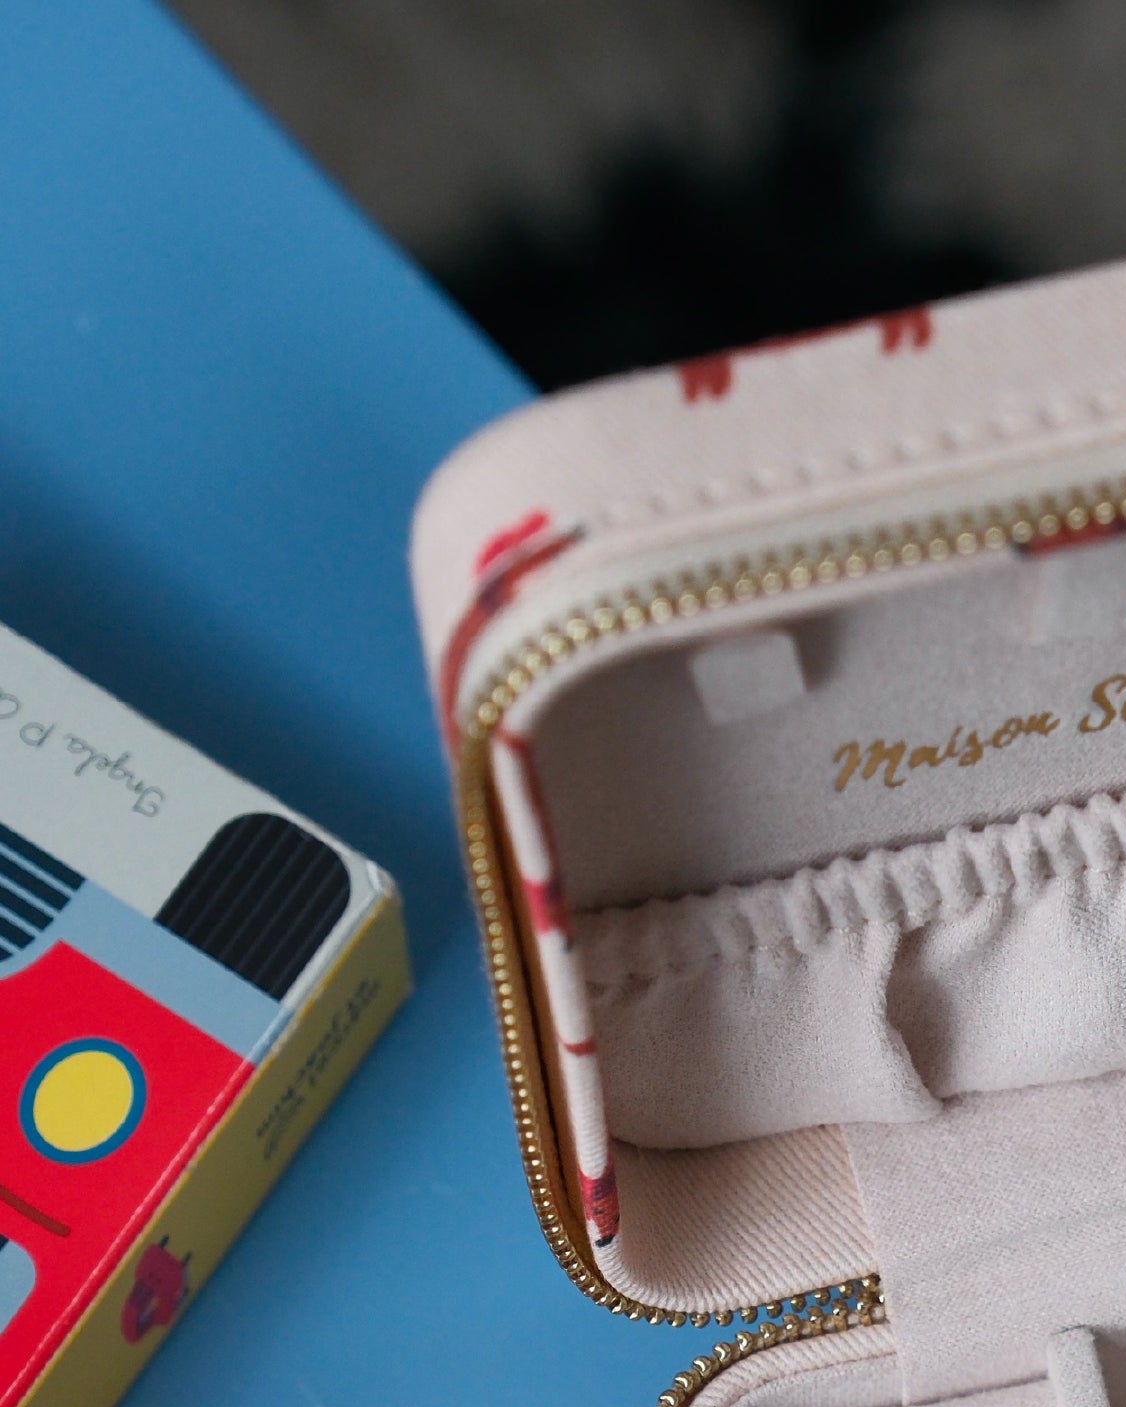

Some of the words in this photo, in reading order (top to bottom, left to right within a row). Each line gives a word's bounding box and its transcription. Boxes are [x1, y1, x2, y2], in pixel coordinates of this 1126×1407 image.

[19, 722, 55, 747] P
[64, 733, 166, 817] Ingela
[833, 711, 1060, 792] Maison
